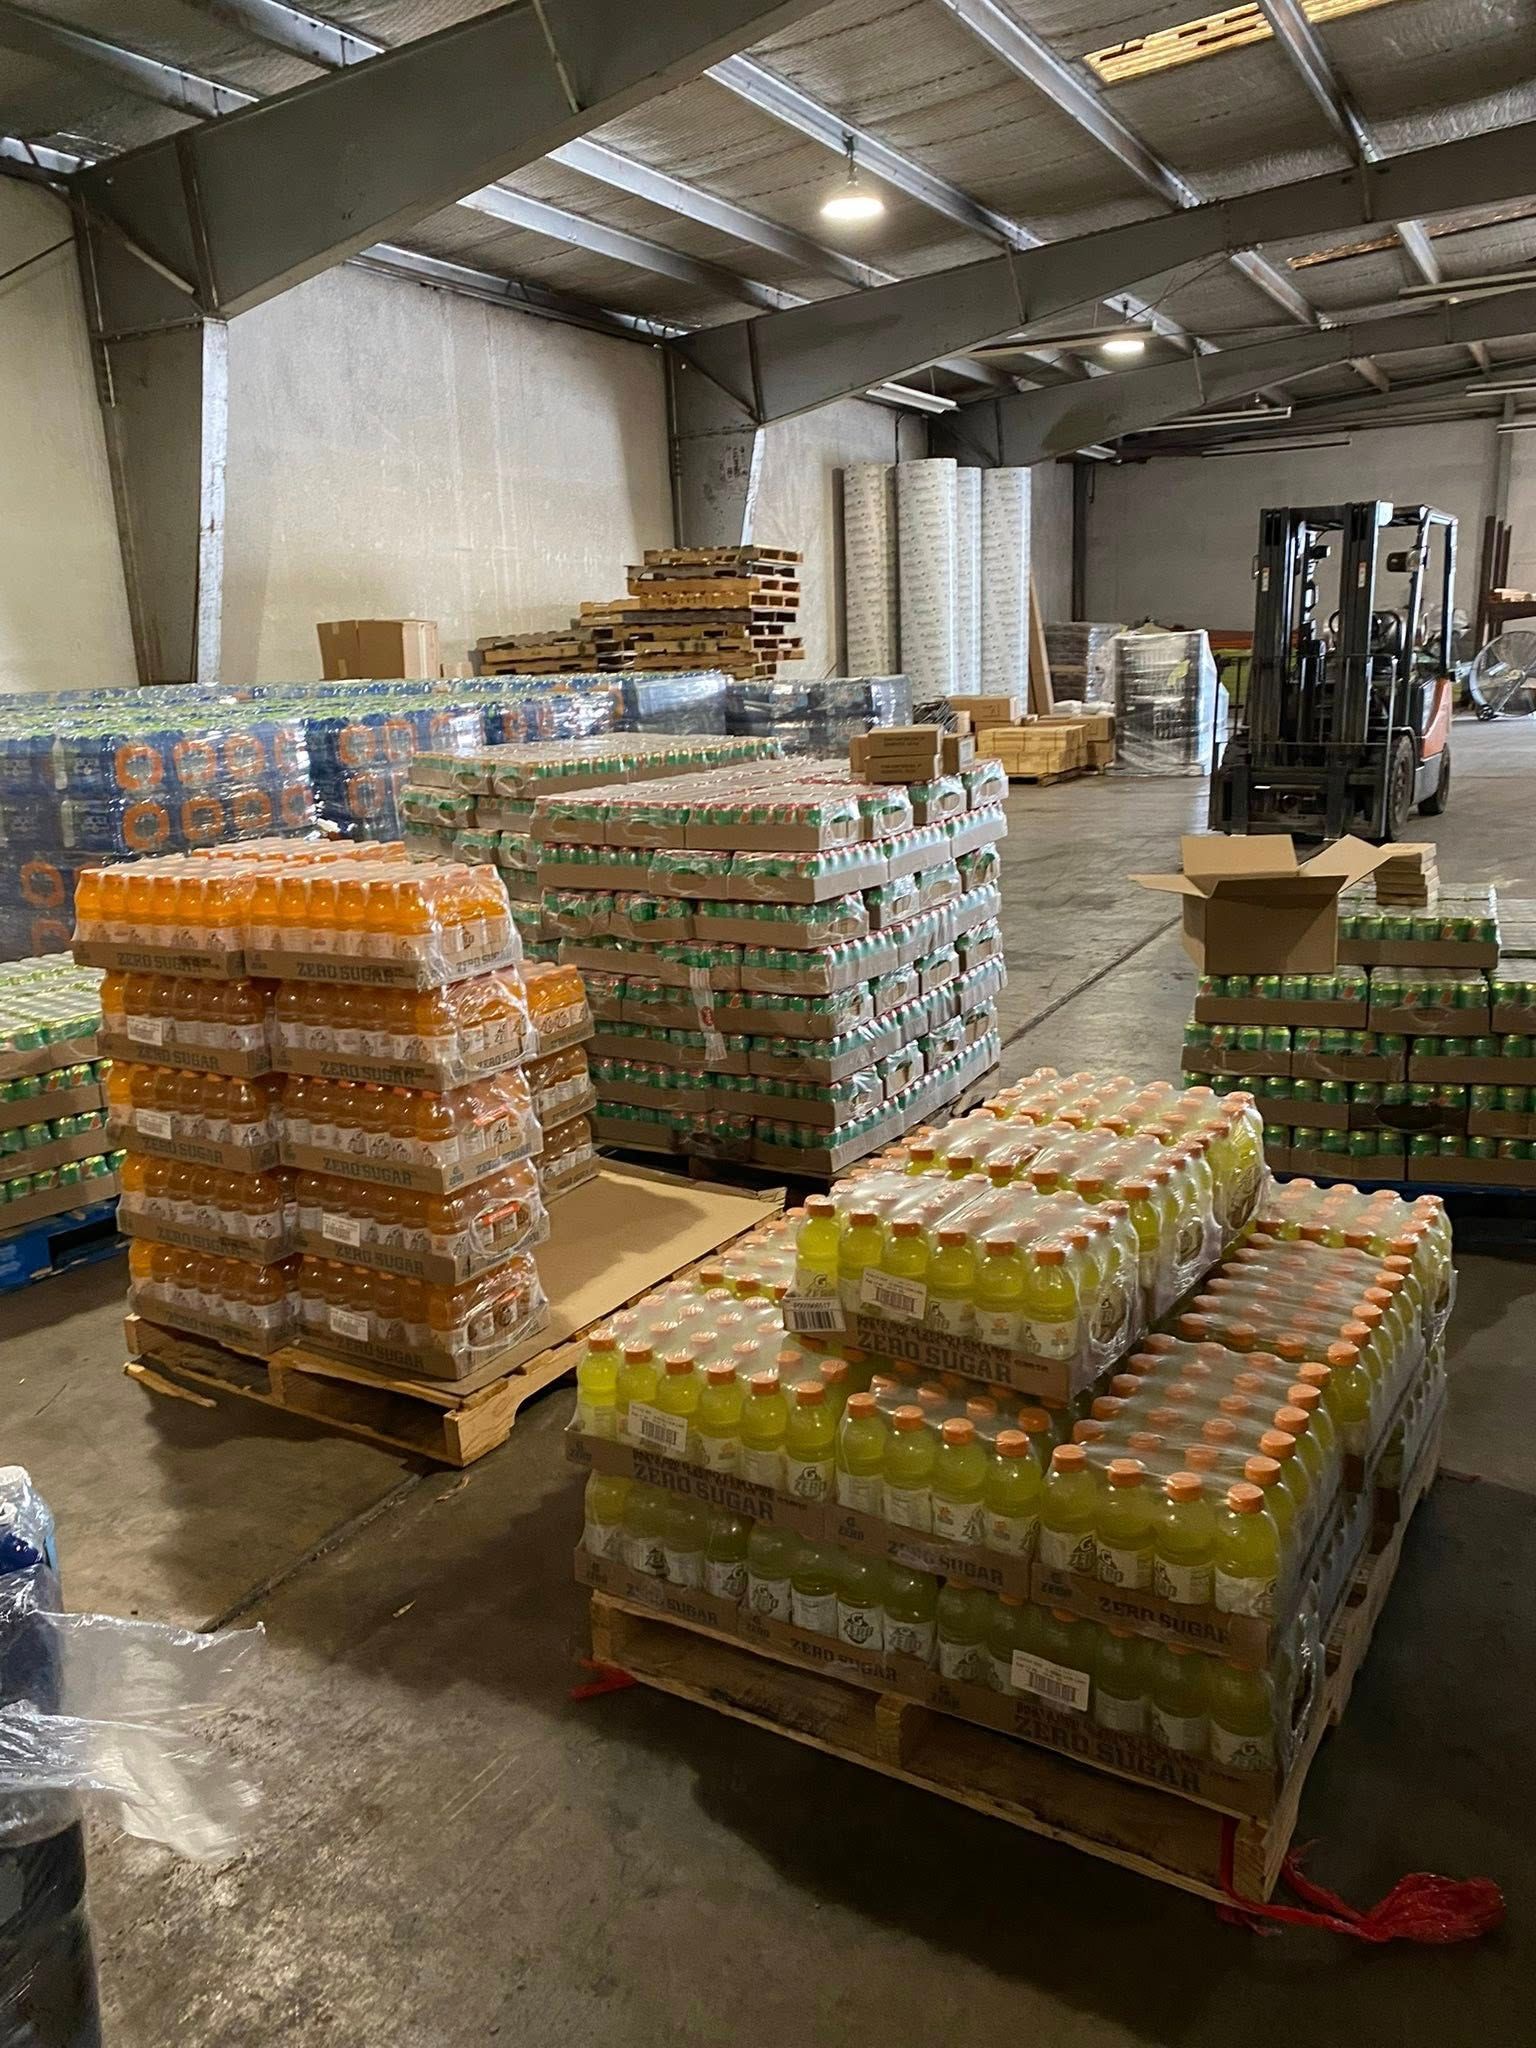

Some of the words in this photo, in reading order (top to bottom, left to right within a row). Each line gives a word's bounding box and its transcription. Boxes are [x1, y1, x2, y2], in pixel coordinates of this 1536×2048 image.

[117, 952, 151, 969] ZERO
[296, 961, 337, 980] ZERO
[340, 964, 395, 984] SUGAR
[137, 1045, 171, 1063] ZERO
[174, 1050, 220, 1069] SUGAR
[320, 1061, 361, 1078] ZERO
[363, 1064, 416, 1085] SUGAR
[142, 1138, 177, 1154] ZERO
[180, 1144, 224, 1163] SUGAR
[322, 1156, 360, 1176] ZERO
[362, 1163, 413, 1187] SUGAR
[335, 1247, 373, 1267] ZERO
[375, 1253, 424, 1276] SUGAR
[376, 1342, 424, 1369] SUGAR
[858, 1330, 920, 1361] ZERO
[925, 1346, 1012, 1384] SUGAR
[633, 1462, 691, 1494] ZERO
[697, 1480, 774, 1521] SUGAR
[940, 1557, 1004, 1587] SUGAR
[1100, 1597, 1154, 1622] ZERO
[790, 1639, 835, 1661] ZERO
[1014, 1714, 1090, 1757] ZERO
[1097, 1738, 1202, 1793] SUGAR
